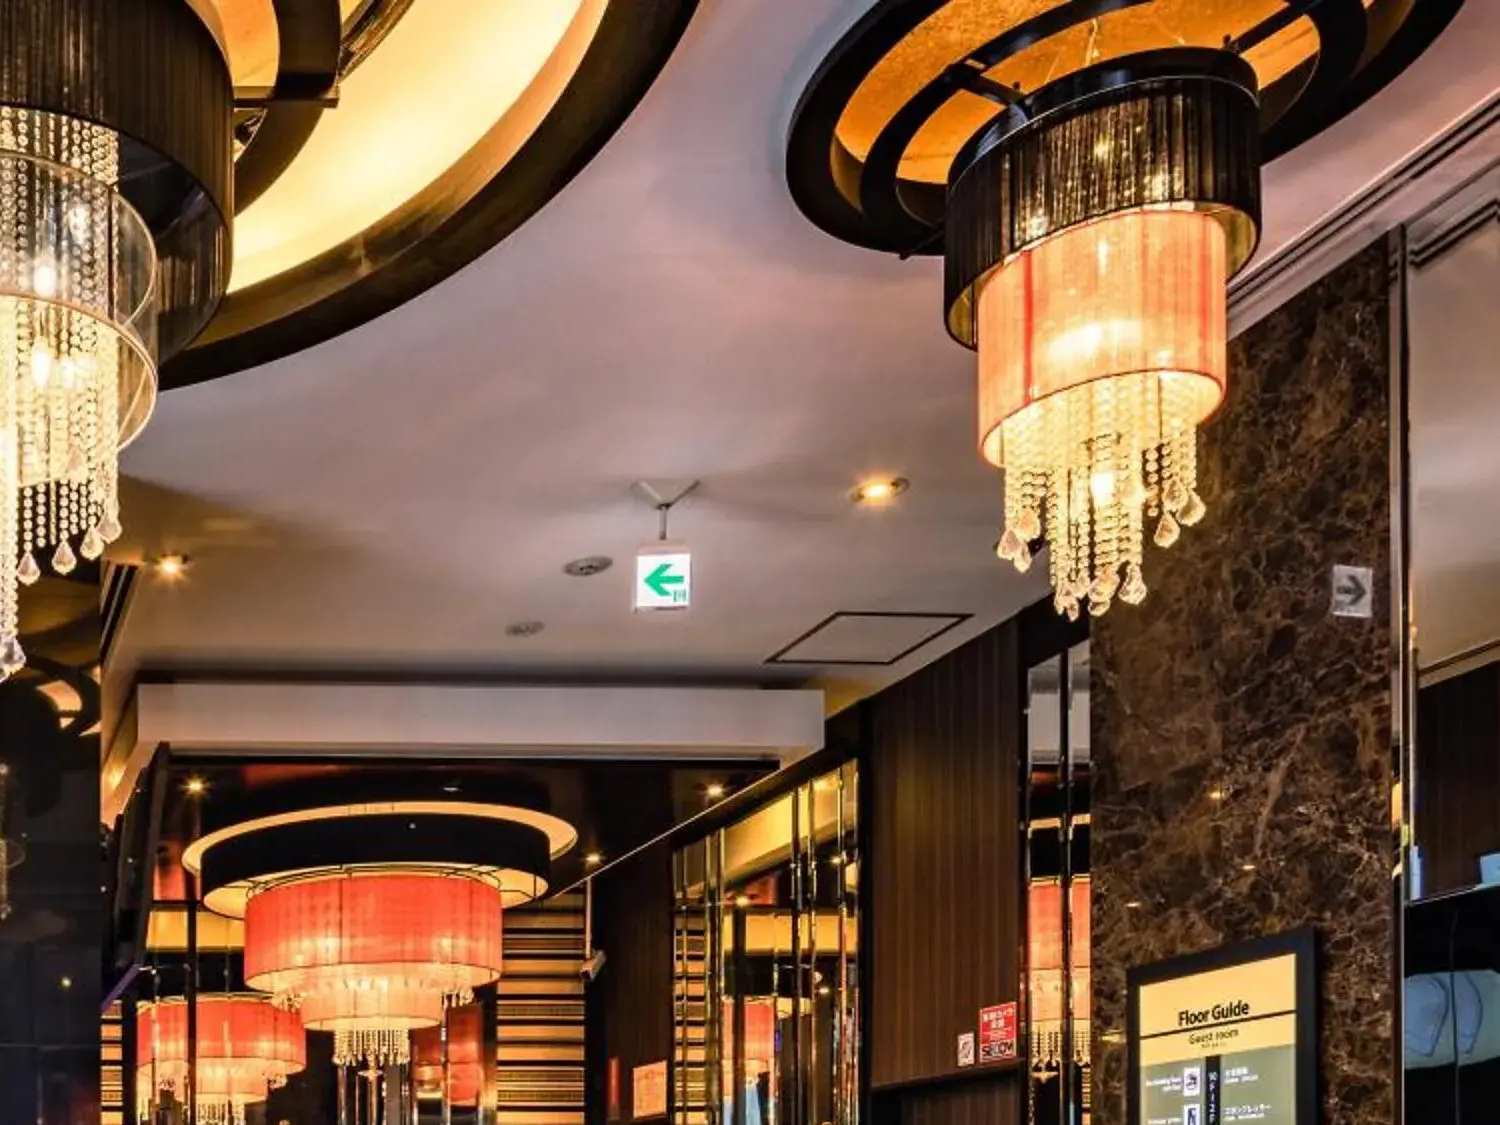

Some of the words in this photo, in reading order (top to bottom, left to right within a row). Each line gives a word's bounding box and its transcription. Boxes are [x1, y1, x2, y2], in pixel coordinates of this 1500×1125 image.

[1178, 1009, 1210, 1026] Floor
[1211, 999, 1250, 1020] Guide
[1189, 1031, 1213, 1044] Guest
[1215, 1029, 1239, 1041] room
